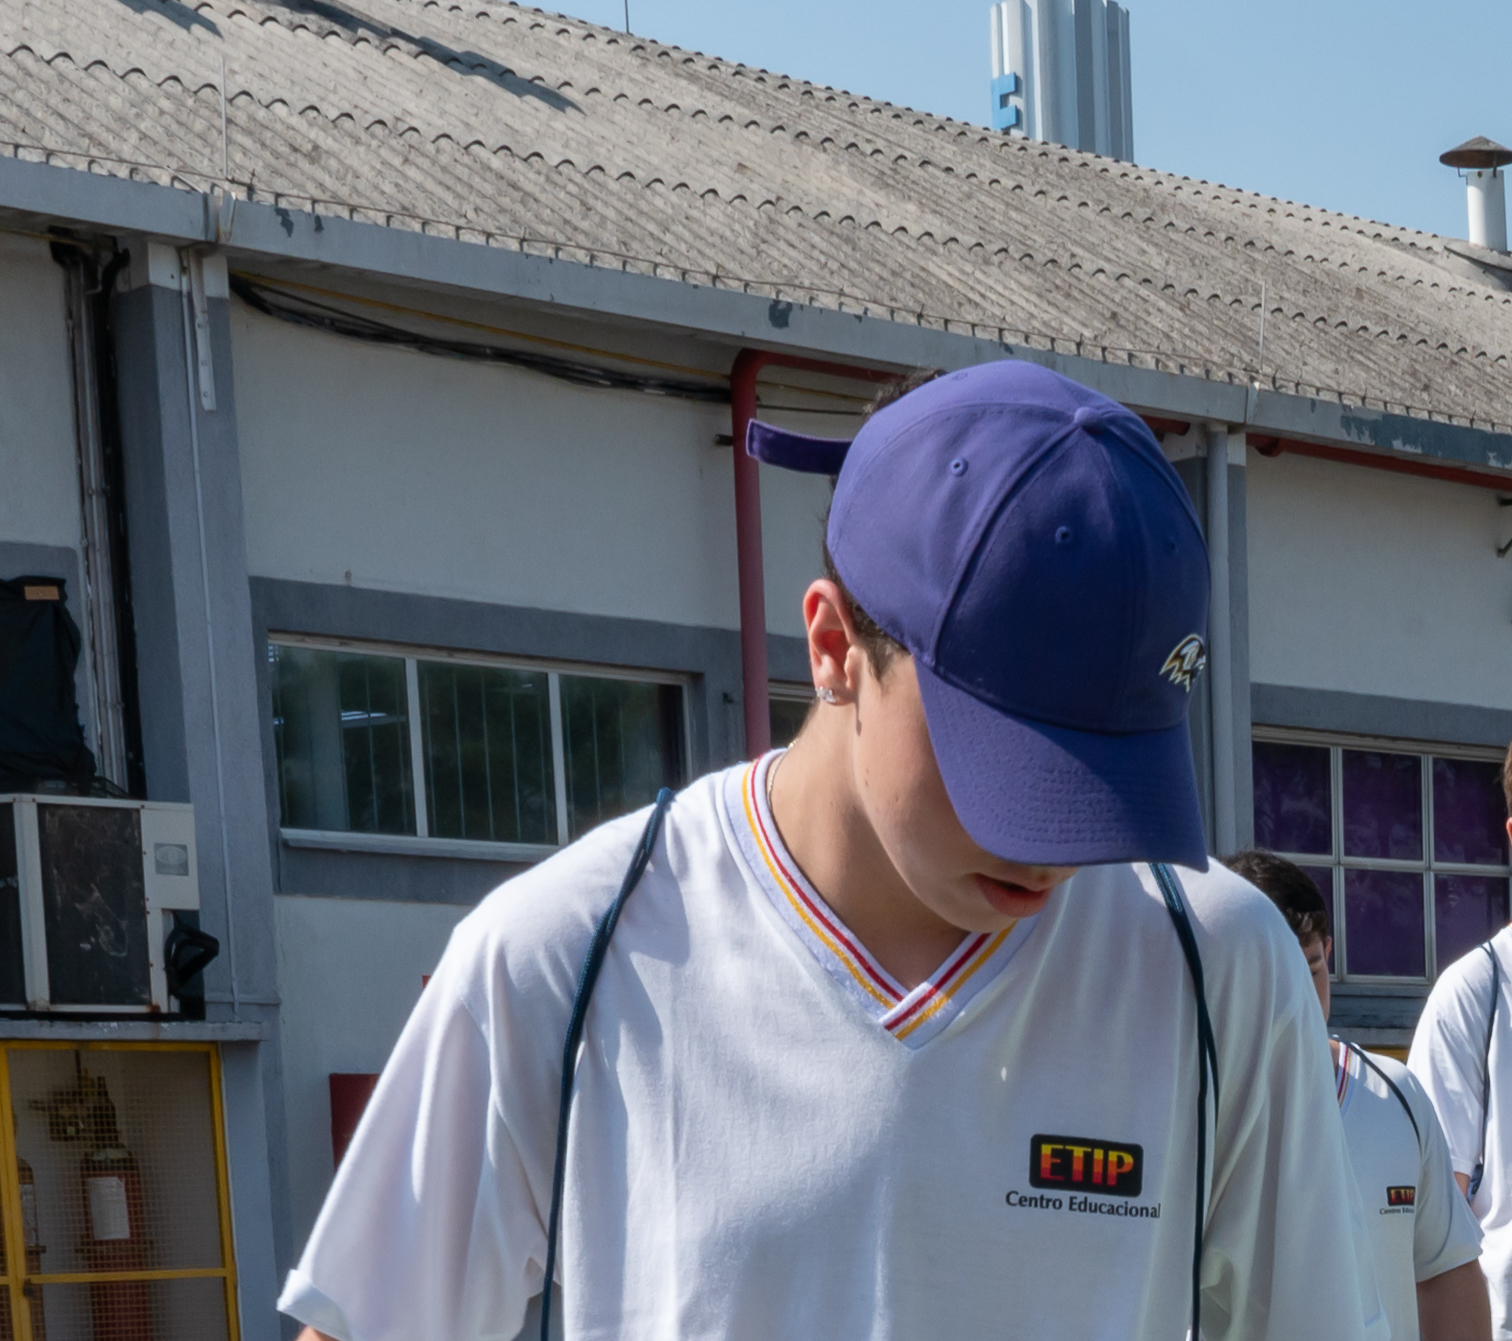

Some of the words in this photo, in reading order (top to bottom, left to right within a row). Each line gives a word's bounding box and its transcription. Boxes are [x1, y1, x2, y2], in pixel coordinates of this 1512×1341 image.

[1039, 1143, 1135, 1187] ETIP
[1005, 1190, 1063, 1211] Centro
[1068, 1195, 1161, 1219] Educacional
